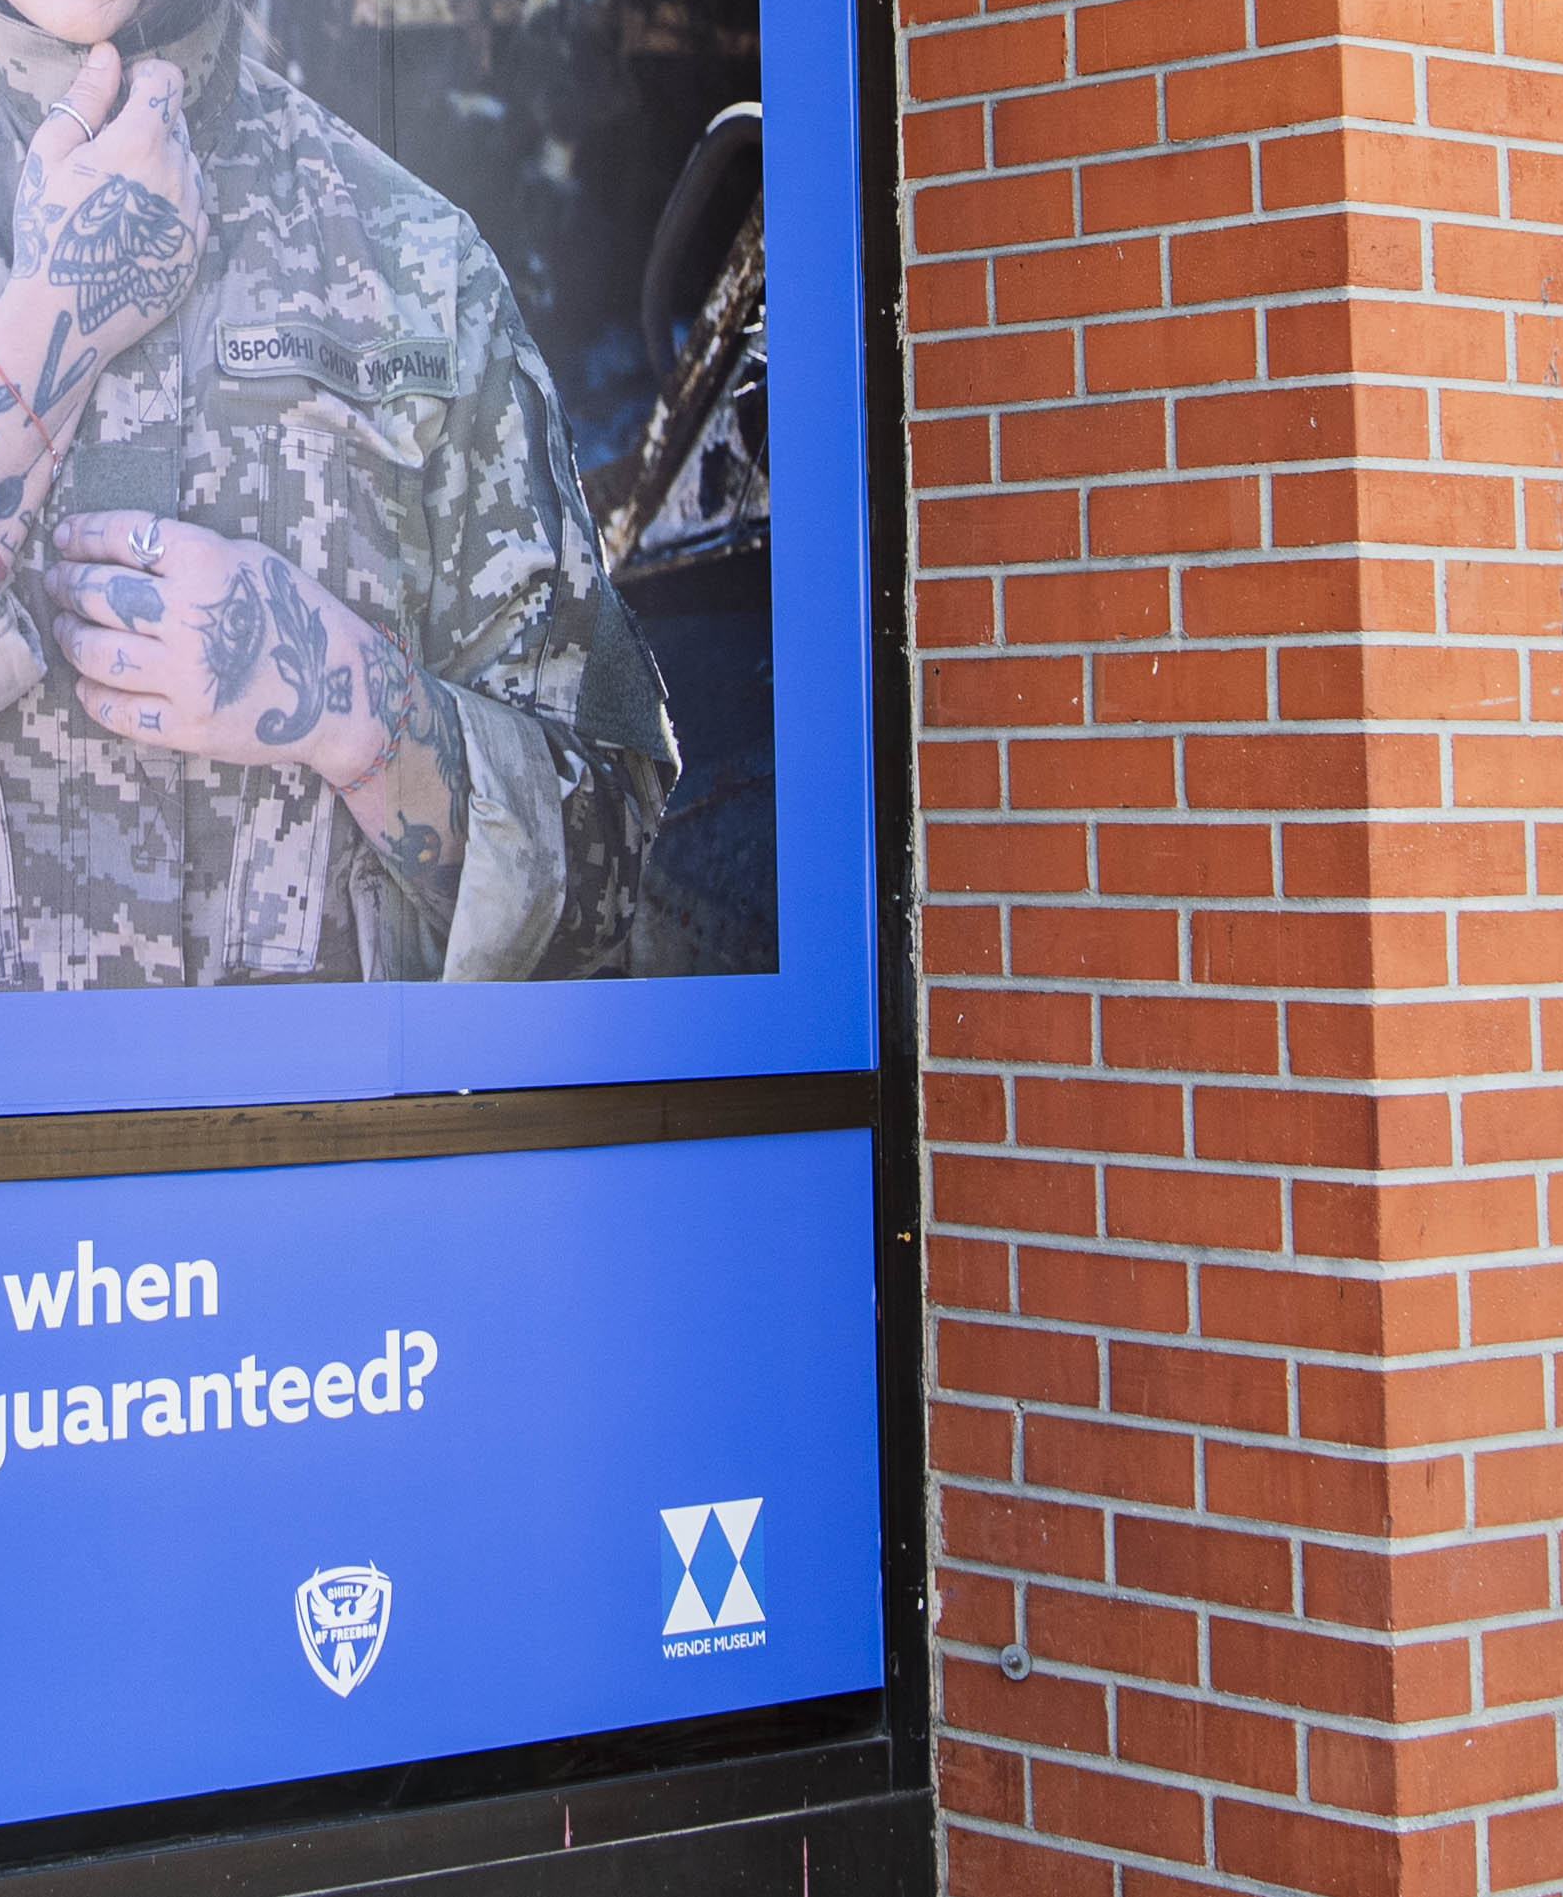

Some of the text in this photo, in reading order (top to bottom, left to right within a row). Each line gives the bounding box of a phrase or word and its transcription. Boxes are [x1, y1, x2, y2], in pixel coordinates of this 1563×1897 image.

[227, 333, 448, 386] ЗБРОЙНІ СИЛИ УКРАЇНИ
[3, 1240, 218, 1331] when
[327, 1584, 364, 1601] SHIELD
[315, 1623, 378, 1645] OF FREEDOM
[662, 1630, 767, 1659] WENDE MUSEUM
